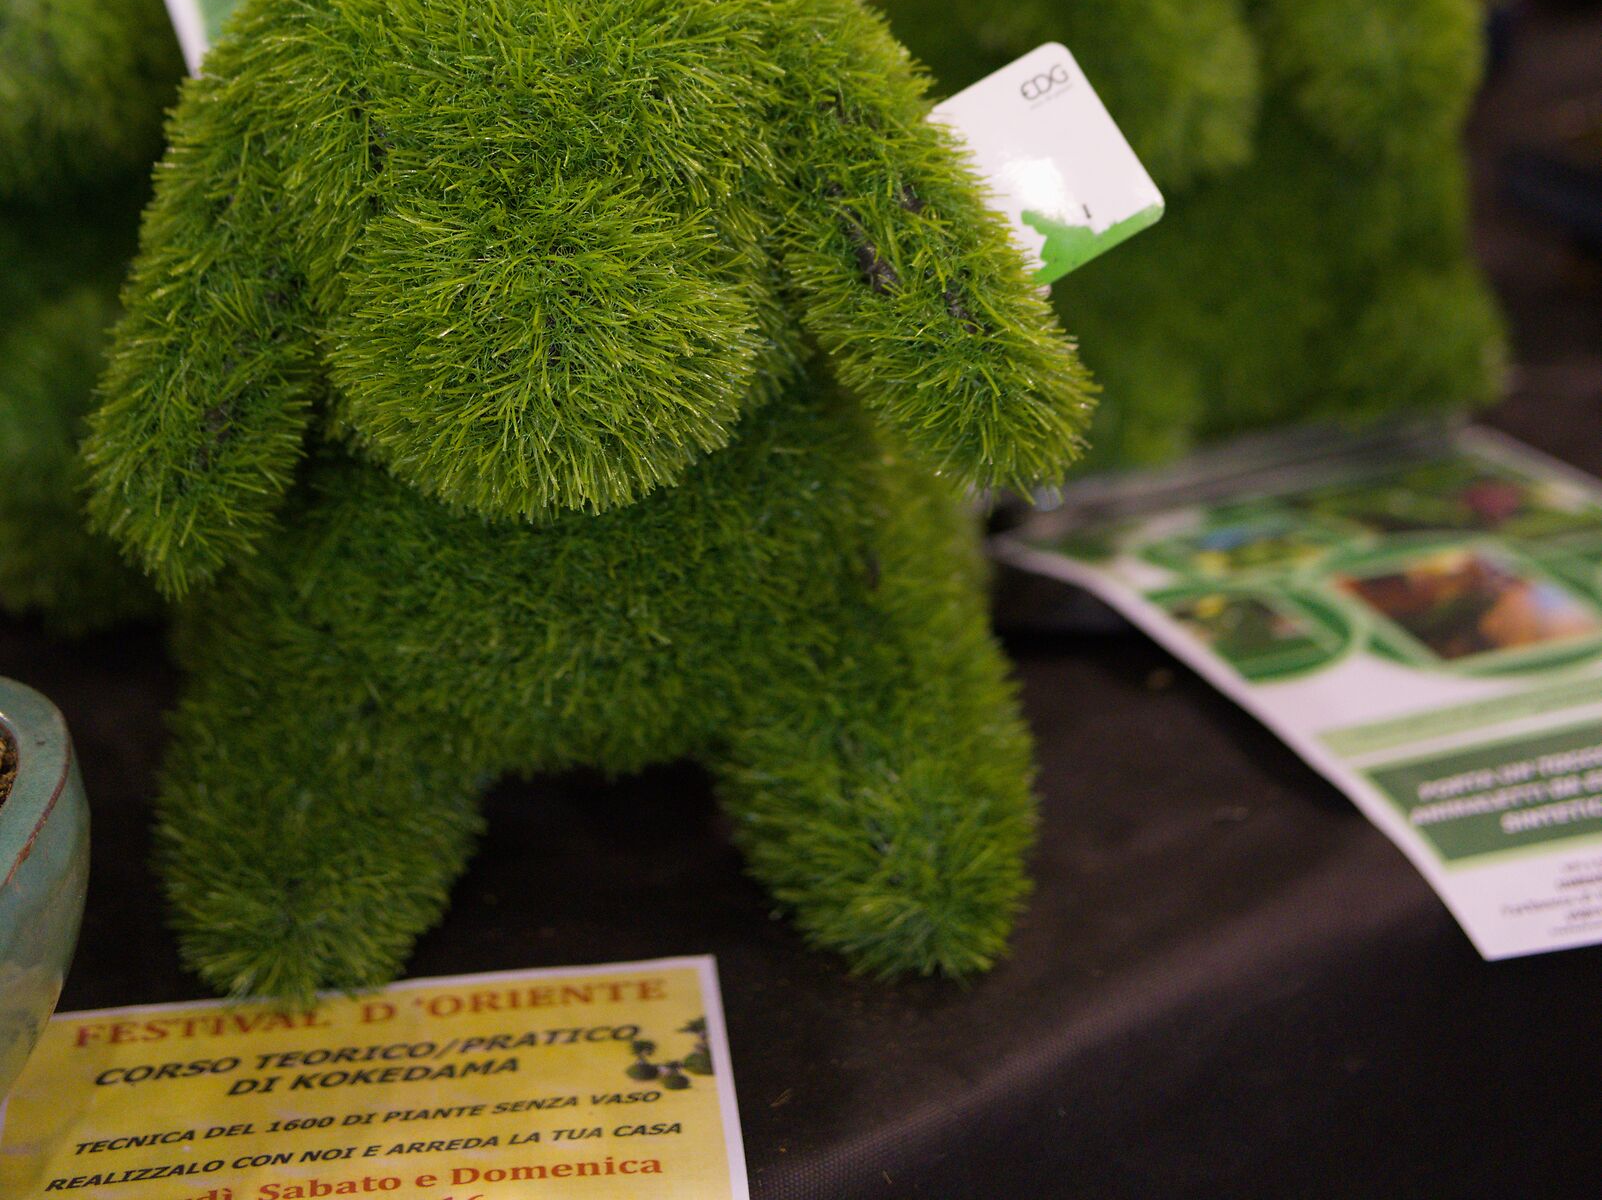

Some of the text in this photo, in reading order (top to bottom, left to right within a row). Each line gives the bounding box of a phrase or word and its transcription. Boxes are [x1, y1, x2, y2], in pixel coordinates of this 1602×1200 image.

[73, 1006, 332, 1047] FESTIVAL
[94, 1024, 641, 1086] CORSO TEORICO/PRATICO
[226, 1057, 518, 1097] DI KOKEDAMA
[74, 1090, 662, 1156] TECNICA DEL 1600 DI PIANTE SENZA VASO
[44, 1122, 683, 1192] REALIZZALO CON NOI E ARREDA LA TUA CASA
[257, 1176, 404, 1200] Sabato
[414, 1173, 438, 1188] e
[451, 1156, 664, 1186] Domenica
